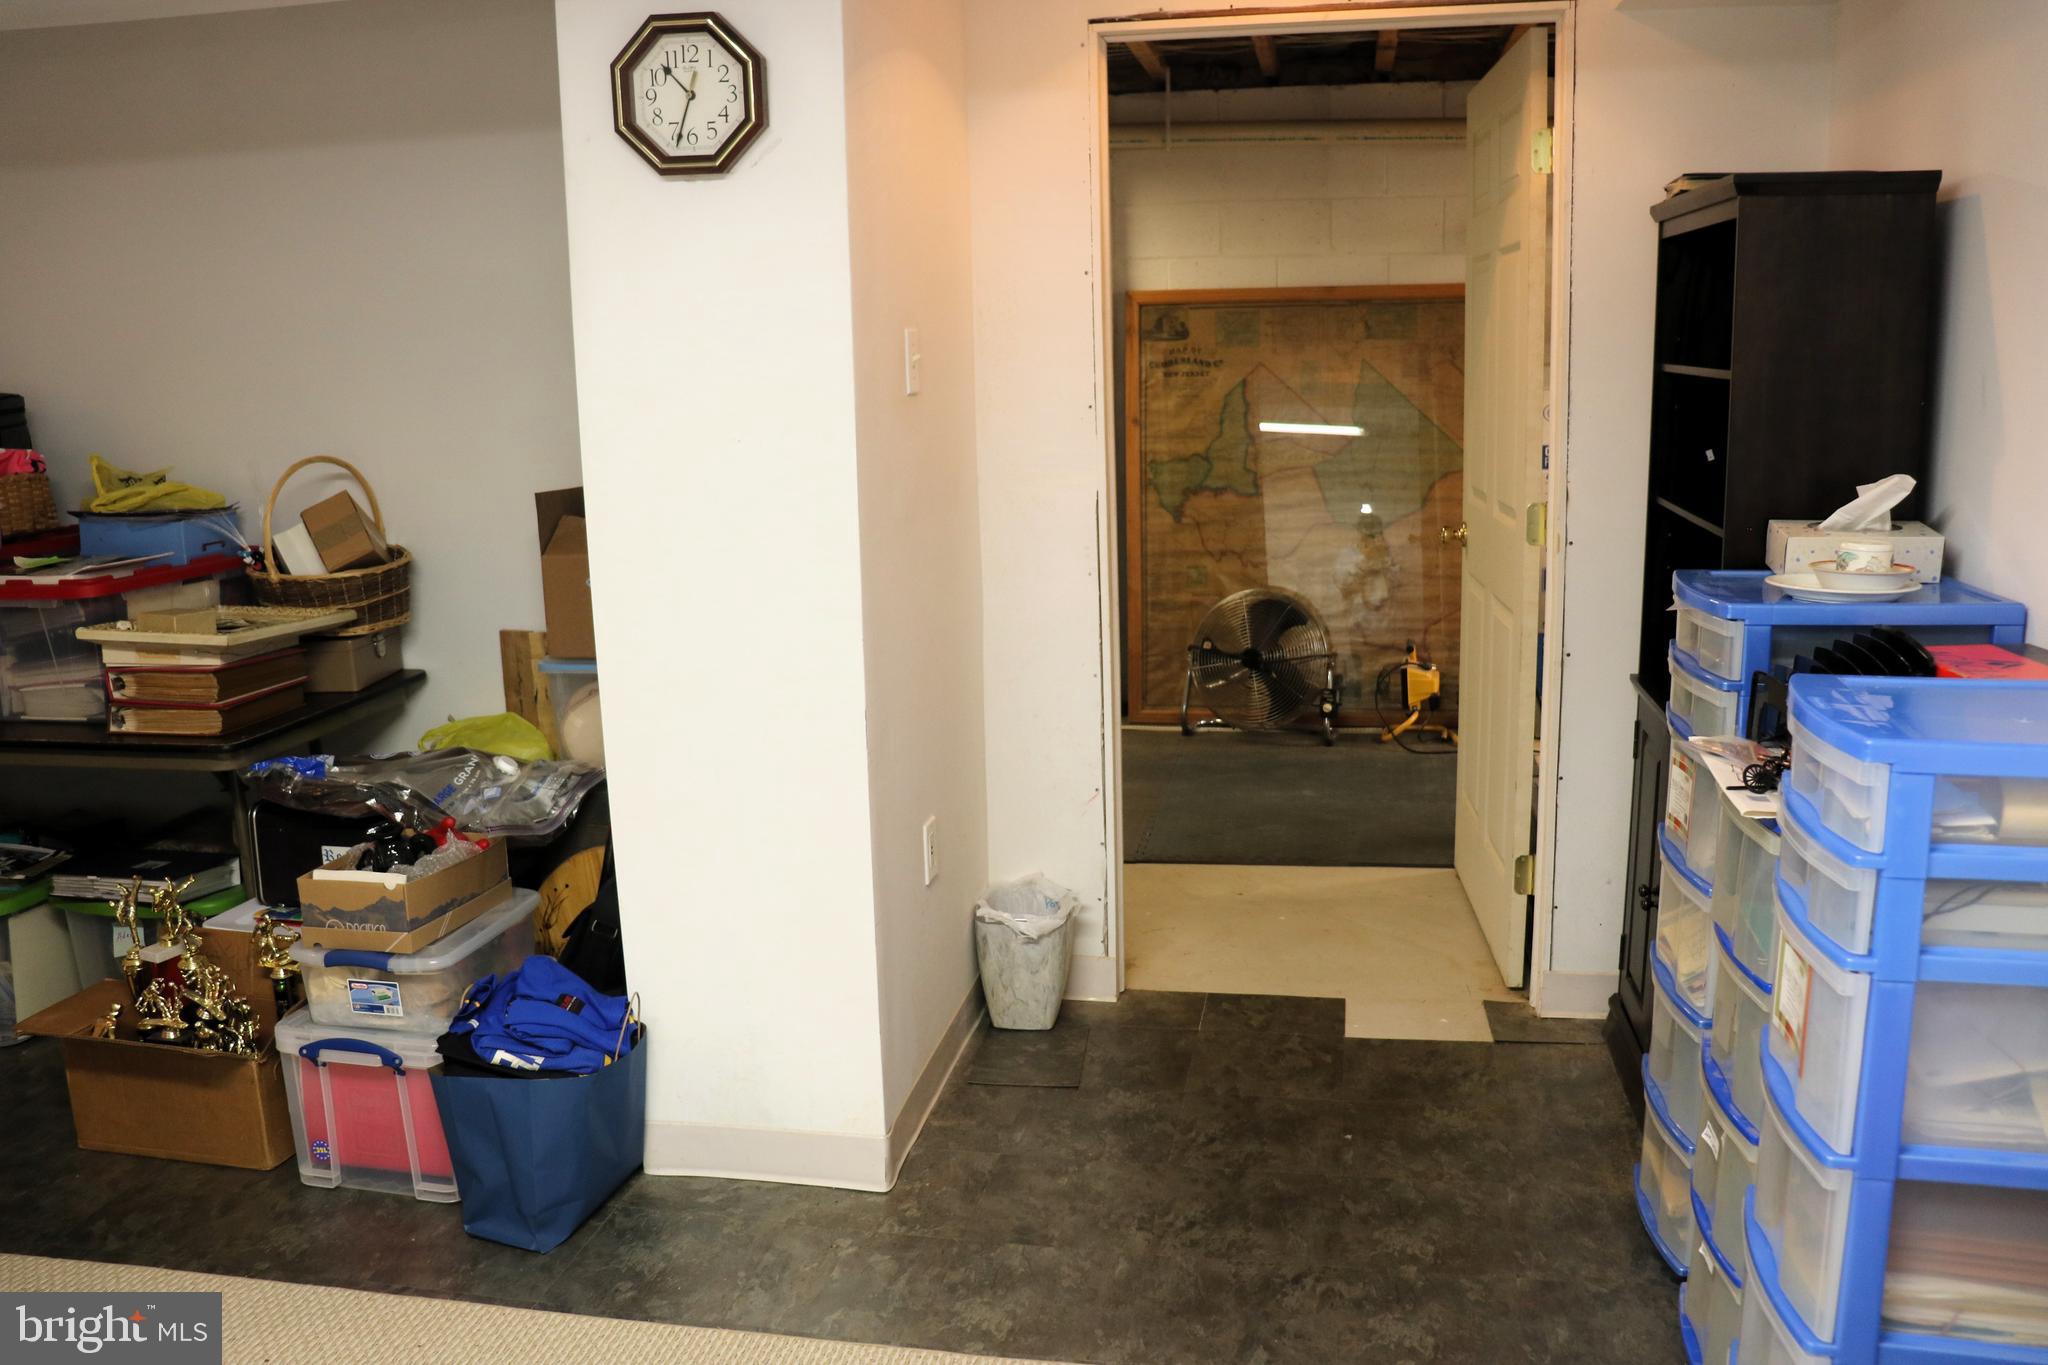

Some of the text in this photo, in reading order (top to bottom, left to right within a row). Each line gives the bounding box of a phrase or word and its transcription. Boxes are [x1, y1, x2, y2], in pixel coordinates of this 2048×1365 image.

[665, 51, 678, 69] 11
[681, 44, 699, 63] 12
[707, 49, 713, 68] 1
[650, 68, 668, 87] 10
[717, 64, 730, 83] 2
[645, 88, 658, 107] 9
[726, 84, 738, 104] 3
[652, 107, 664, 126] 8
[718, 105, 730, 124] 4
[668, 121, 680, 141] 7
[686, 127, 699, 146] 6
[706, 121, 718, 140] 5
